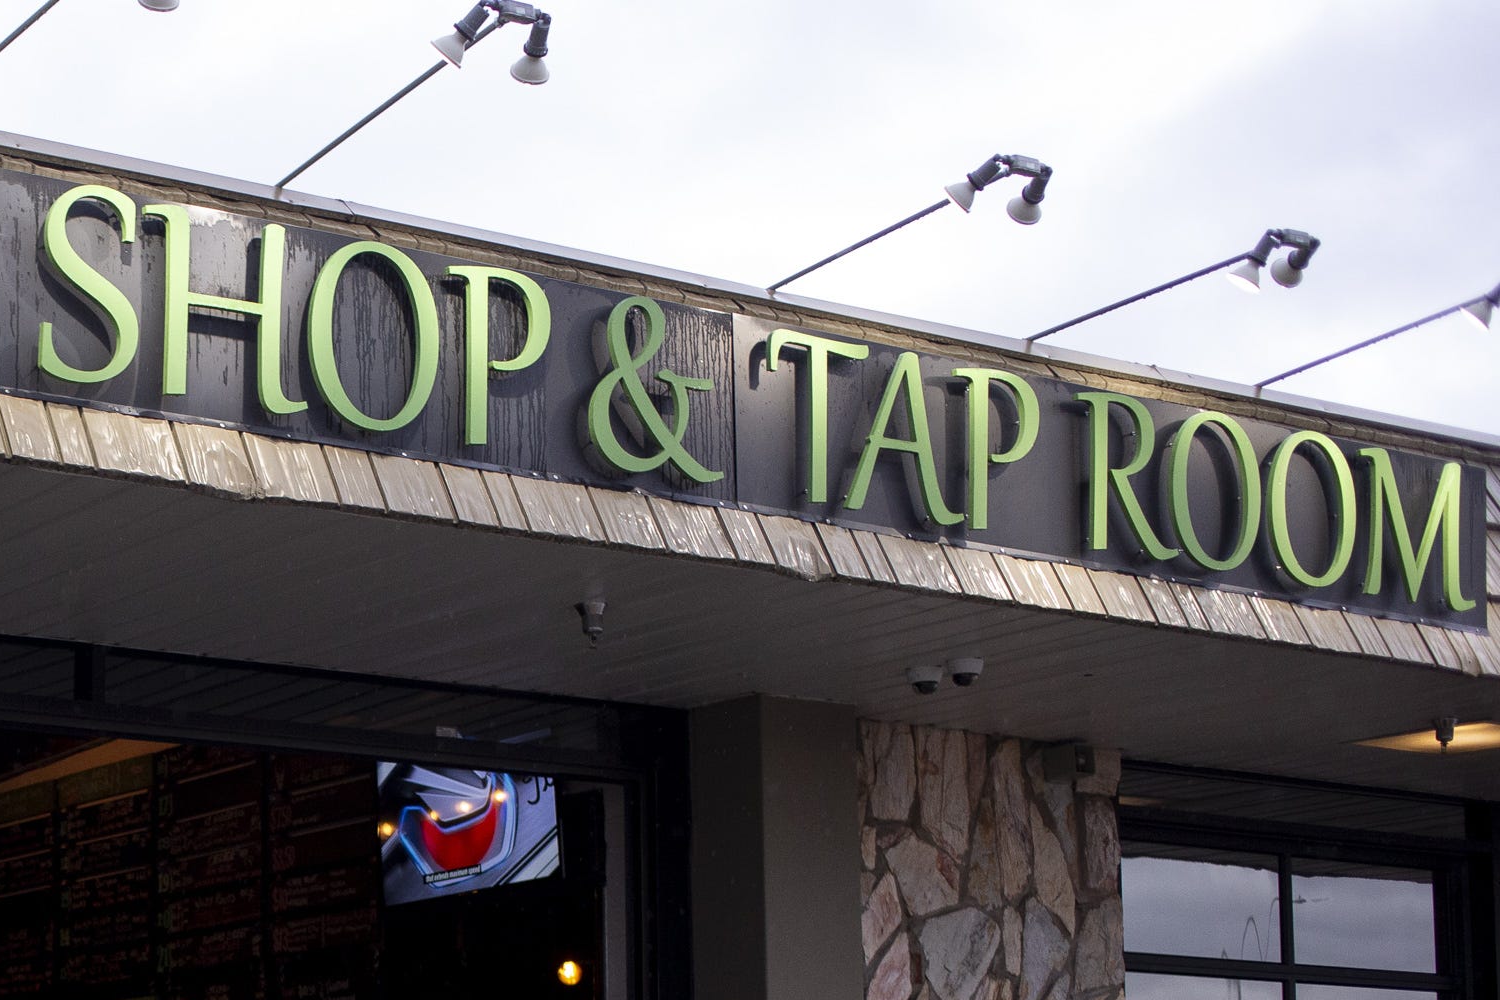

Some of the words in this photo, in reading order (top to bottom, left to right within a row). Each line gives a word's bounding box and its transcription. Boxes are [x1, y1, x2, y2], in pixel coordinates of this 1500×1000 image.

[38, 184, 551, 445] SHOP
[589, 296, 724, 483] &
[767, 329, 1039, 530] TAP
[1075, 392, 1475, 611] ROOM
